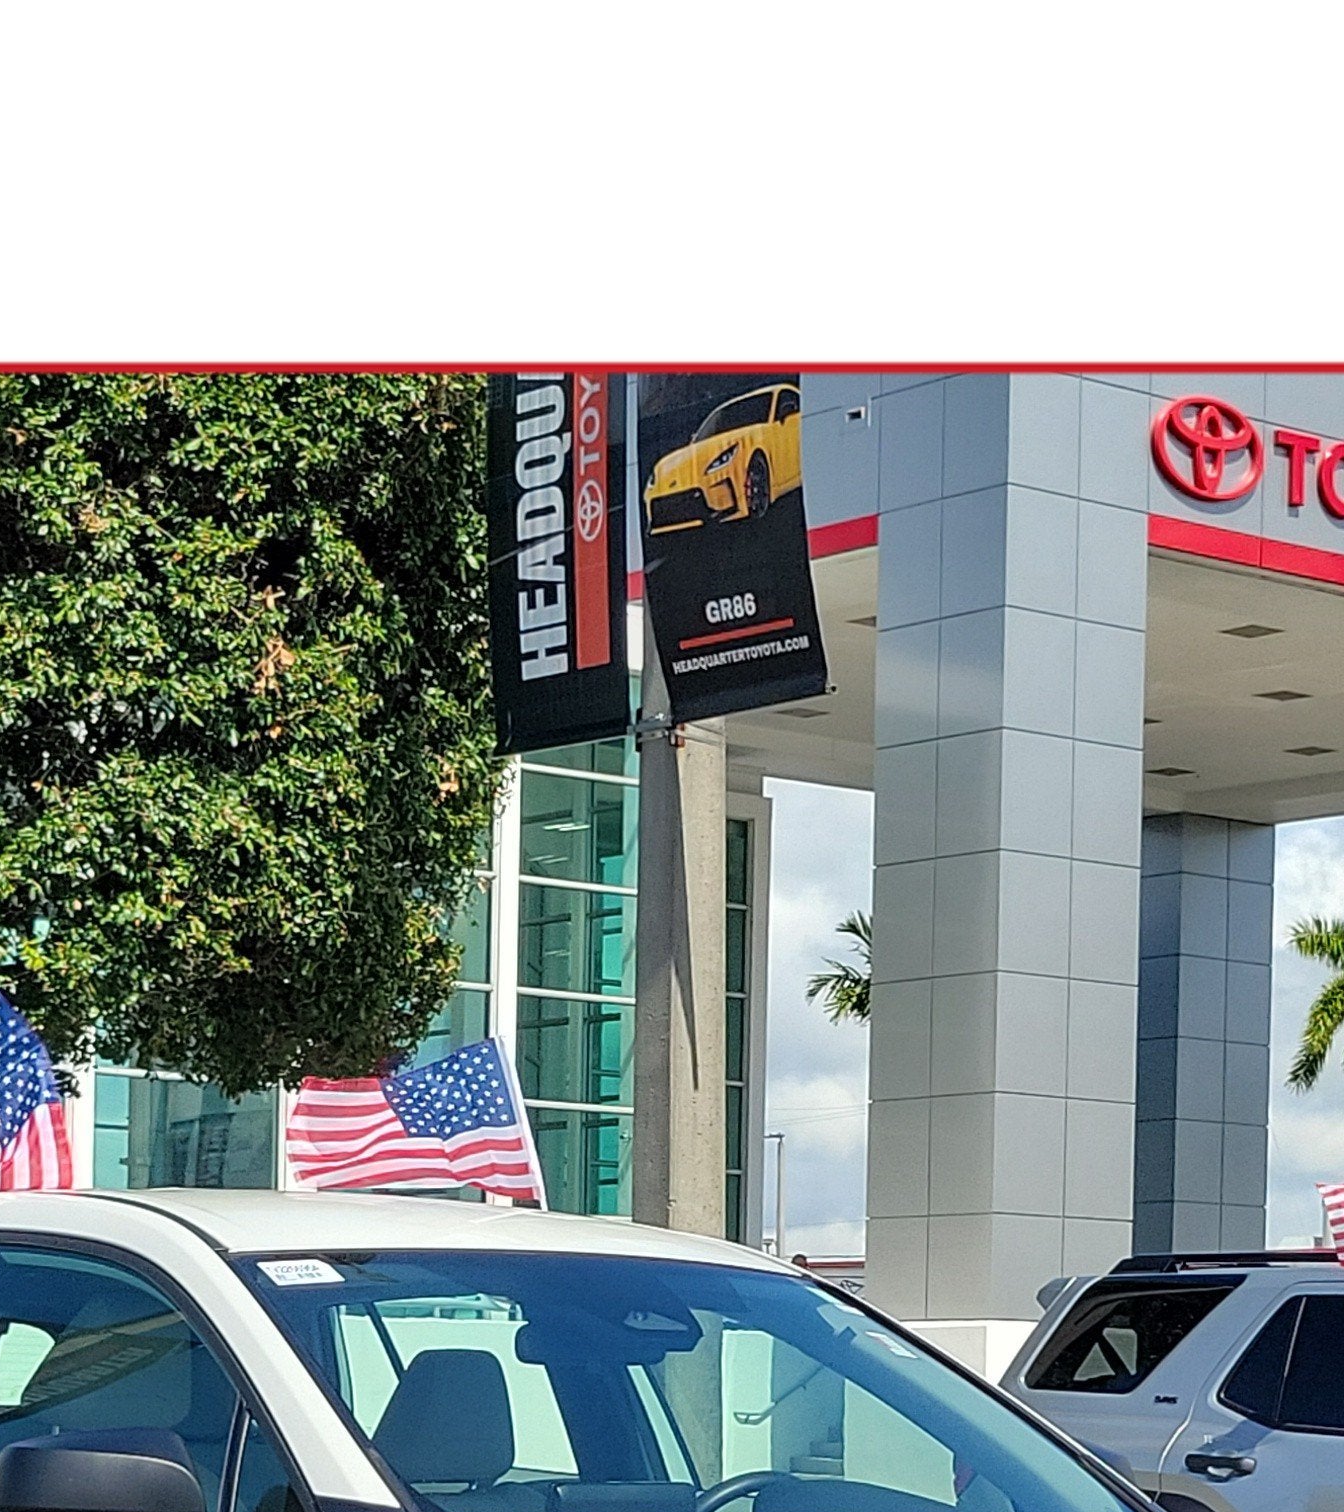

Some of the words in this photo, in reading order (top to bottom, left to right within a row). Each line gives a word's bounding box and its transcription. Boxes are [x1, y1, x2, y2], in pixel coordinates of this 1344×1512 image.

[515, 372, 571, 682] HEADQU
[704, 592, 757, 624] GR86
[672, 635, 810, 675] HEADQUARTERTOYOTA.COM
